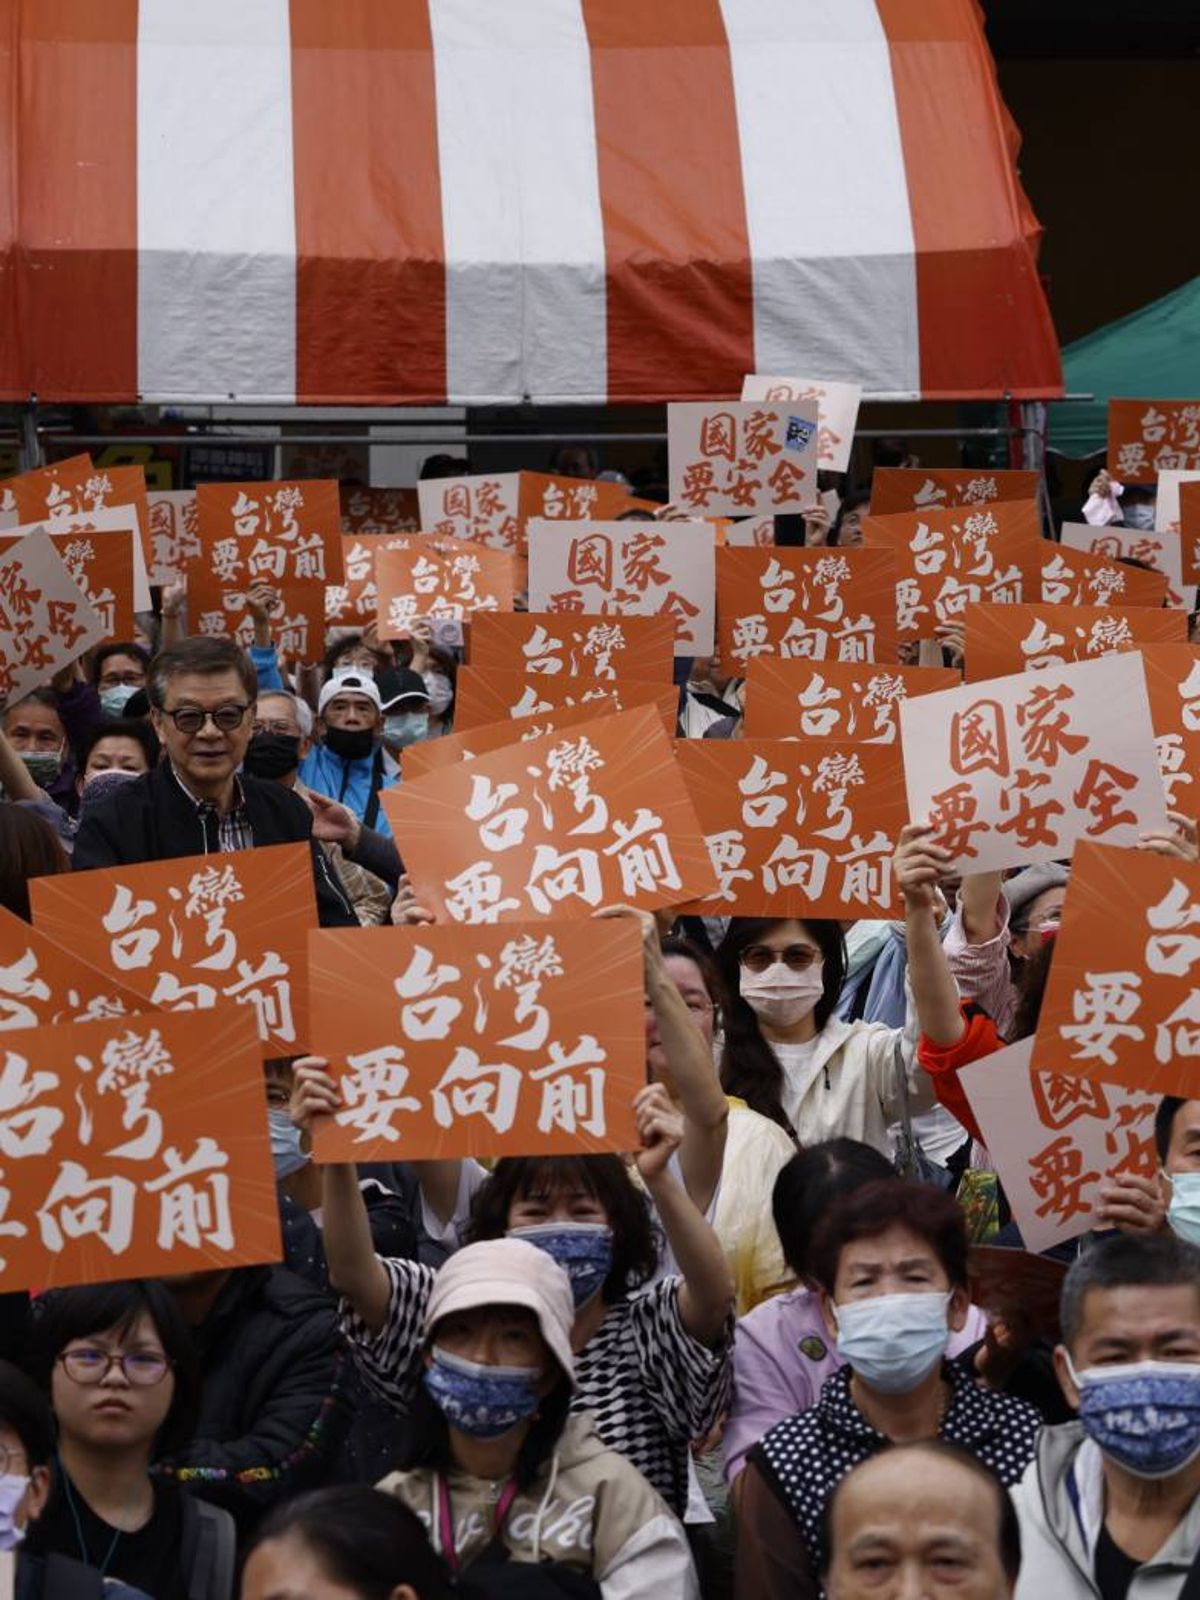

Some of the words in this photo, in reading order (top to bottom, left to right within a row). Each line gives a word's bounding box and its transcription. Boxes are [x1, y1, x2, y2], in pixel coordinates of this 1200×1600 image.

[699, 411, 783, 462] 國家
[231, 487, 304, 541] 台灣
[444, 481, 506, 519] 國家
[542, 482, 599, 520] 台灣
[681, 458, 805, 507] 要安全
[212, 533, 326, 581] 要向前
[567, 532, 672, 592] 國家
[909, 511, 999, 576] 台灣
[325, 582, 378, 620] 要向
[412, 555, 481, 600] 台灣
[760, 555, 851, 622] 台灣
[896, 565, 1024, 630] 要向前
[1041, 554, 1127, 607] 台灣
[522, 623, 626, 680] 台灣
[730, 614, 876, 664] 要向前
[798, 673, 907, 744] 台灣
[950, 684, 1089, 777] 國家
[465, 736, 608, 851] 台灣
[738, 752, 865, 840] 台灣
[928, 759, 1138, 858] 要安全
[445, 808, 683, 923] 要向前
[702, 830, 897, 908] 要向前
[102, 864, 244, 970] 台灣
[394, 934, 564, 1051] 台灣
[0, 1028, 174, 1160] 台灣
[335, 1035, 608, 1144] 要向前
[1028, 1103, 1157, 1227] 要安
